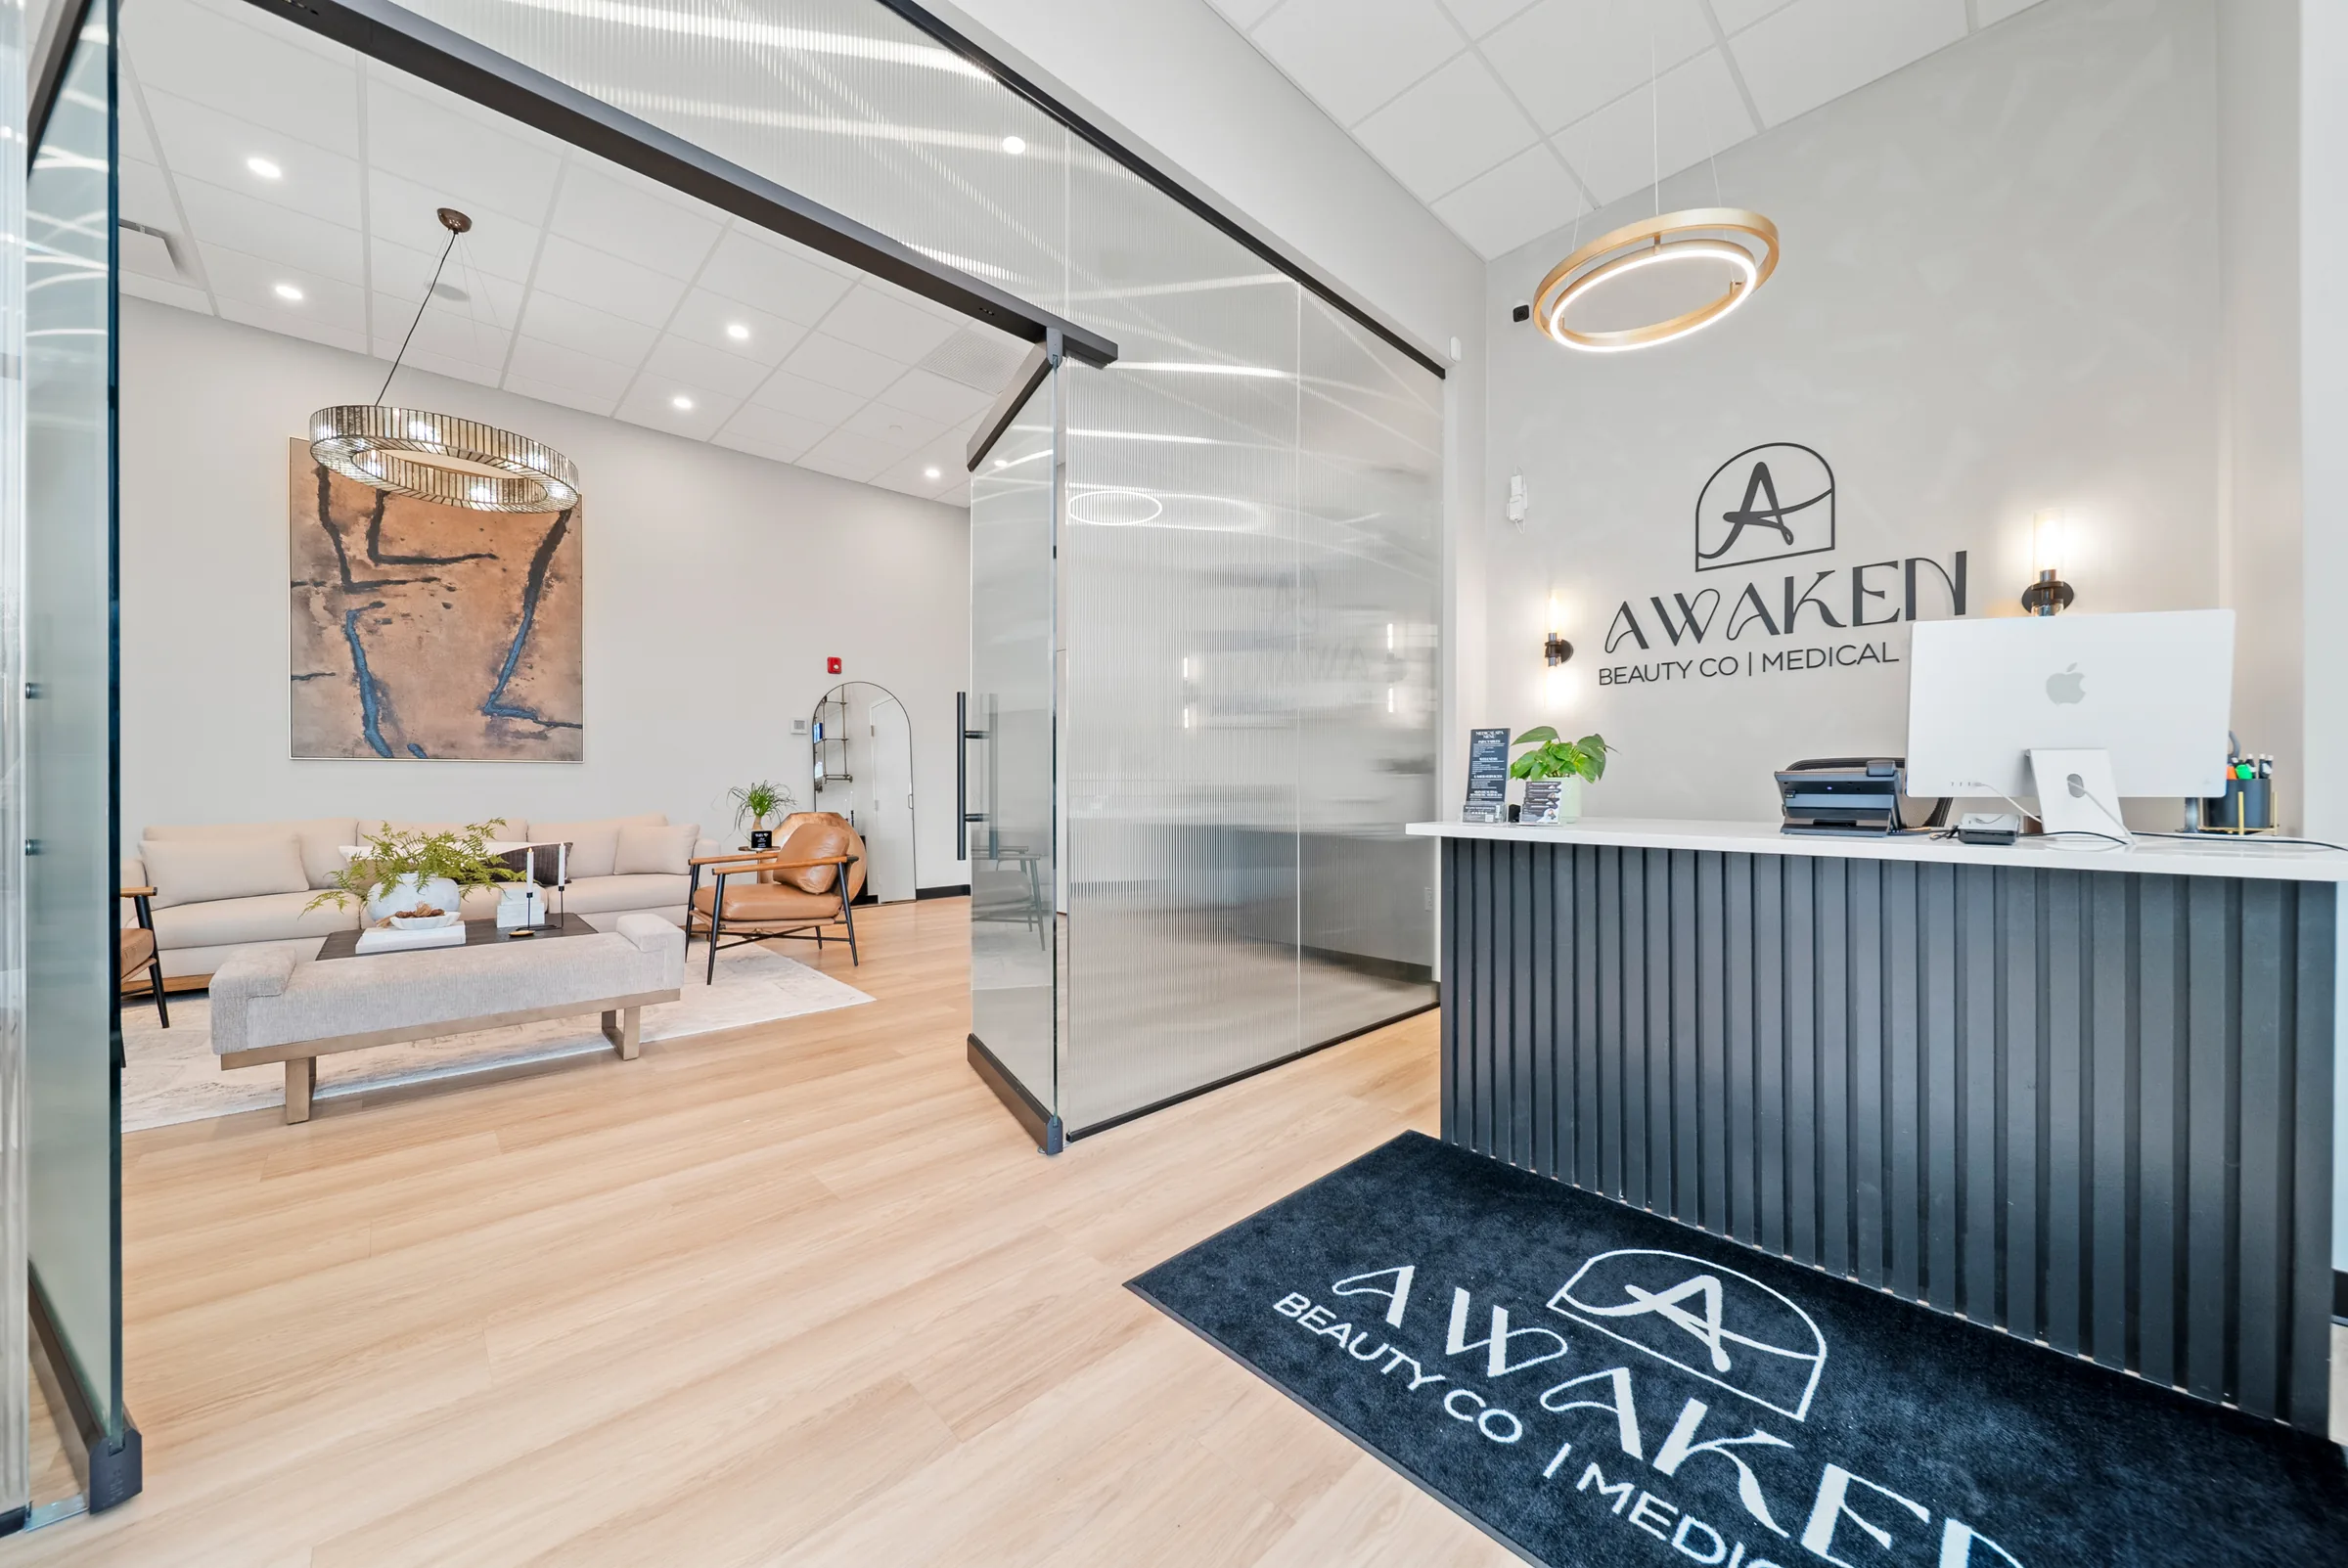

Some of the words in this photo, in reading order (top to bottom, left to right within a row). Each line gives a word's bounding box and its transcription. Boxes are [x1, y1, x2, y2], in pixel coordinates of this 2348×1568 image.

[1604, 550, 1967, 654] AWAKEN
[1599, 659, 1693, 686] BEAUTY
[1699, 655, 1738, 678] CO
[1762, 642, 1900, 673] MEDICAL
[1272, 1291, 1447, 1391] BEAUTY
[1443, 1388, 1523, 1444] CO
[1575, 1461, 1783, 1568] MEDI
